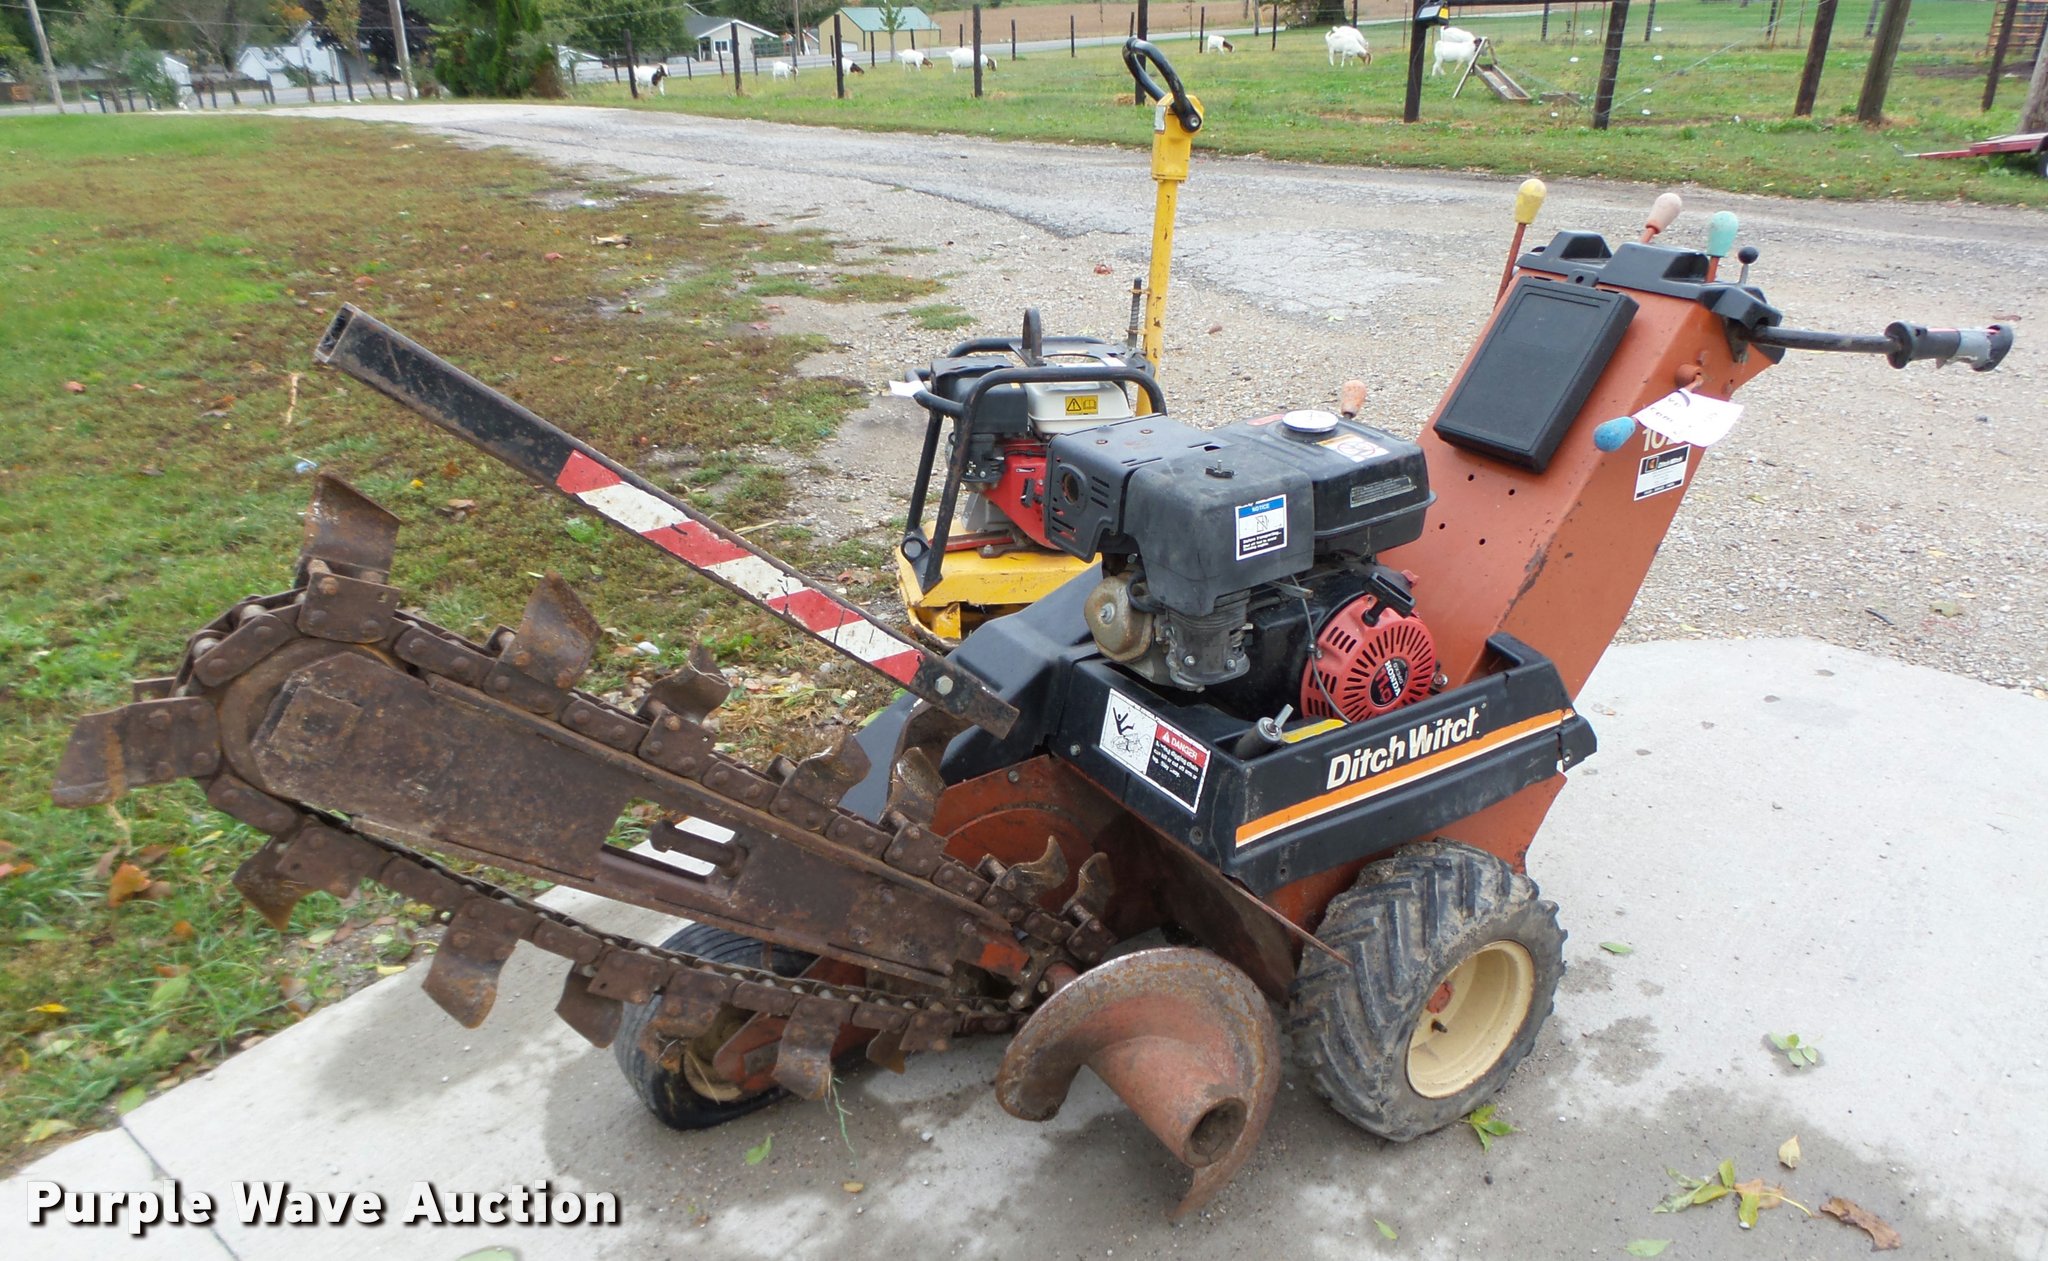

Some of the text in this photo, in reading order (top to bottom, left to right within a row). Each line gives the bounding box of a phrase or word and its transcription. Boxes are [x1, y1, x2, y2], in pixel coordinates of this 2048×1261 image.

[1252, 504, 1270, 512] NOTICE
[1384, 660, 1402, 696] HONDA
[1171, 738, 1198, 760] DANGER
[1326, 735, 1406, 790] Ditch
